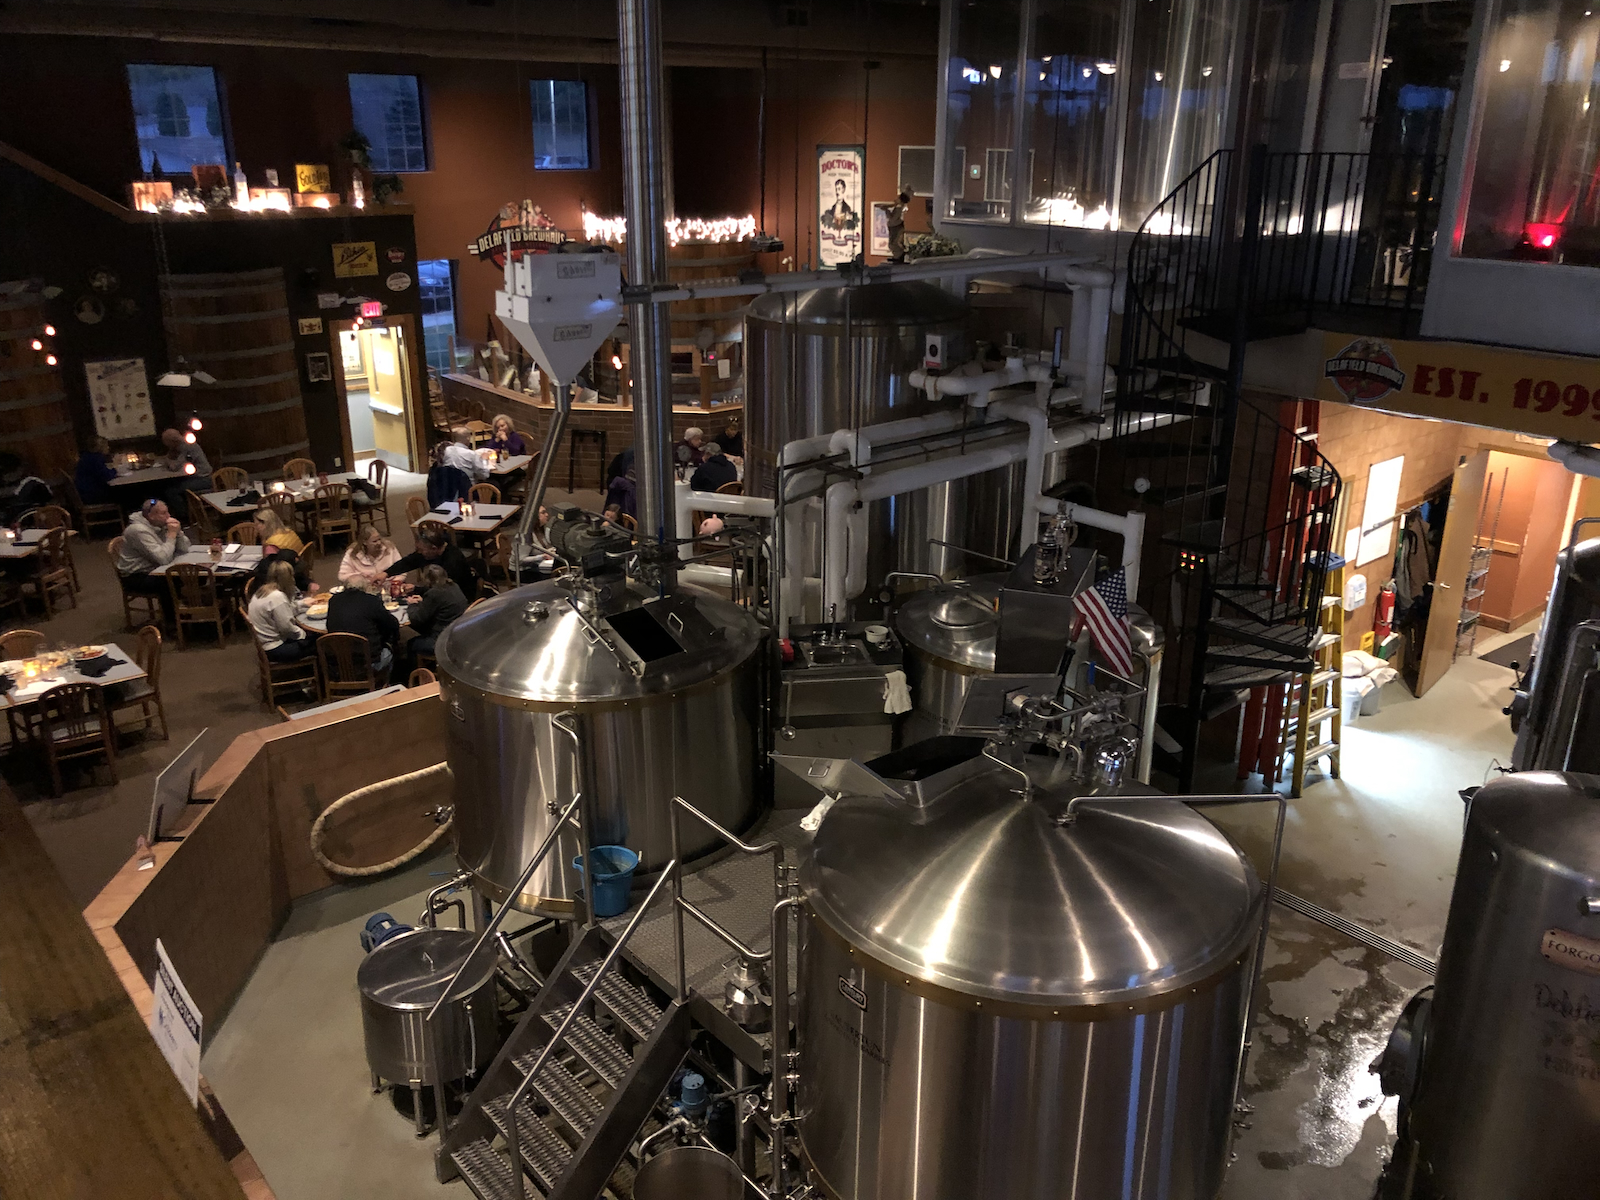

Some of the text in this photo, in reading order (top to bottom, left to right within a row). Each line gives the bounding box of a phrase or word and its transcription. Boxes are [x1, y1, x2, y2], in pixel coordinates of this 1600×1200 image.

[821, 159, 859, 174] DOCTOR'S
[478, 229, 520, 253] DELAFILD
[363, 302, 381, 317] EXIT
[1412, 364, 1489, 404] EST.
